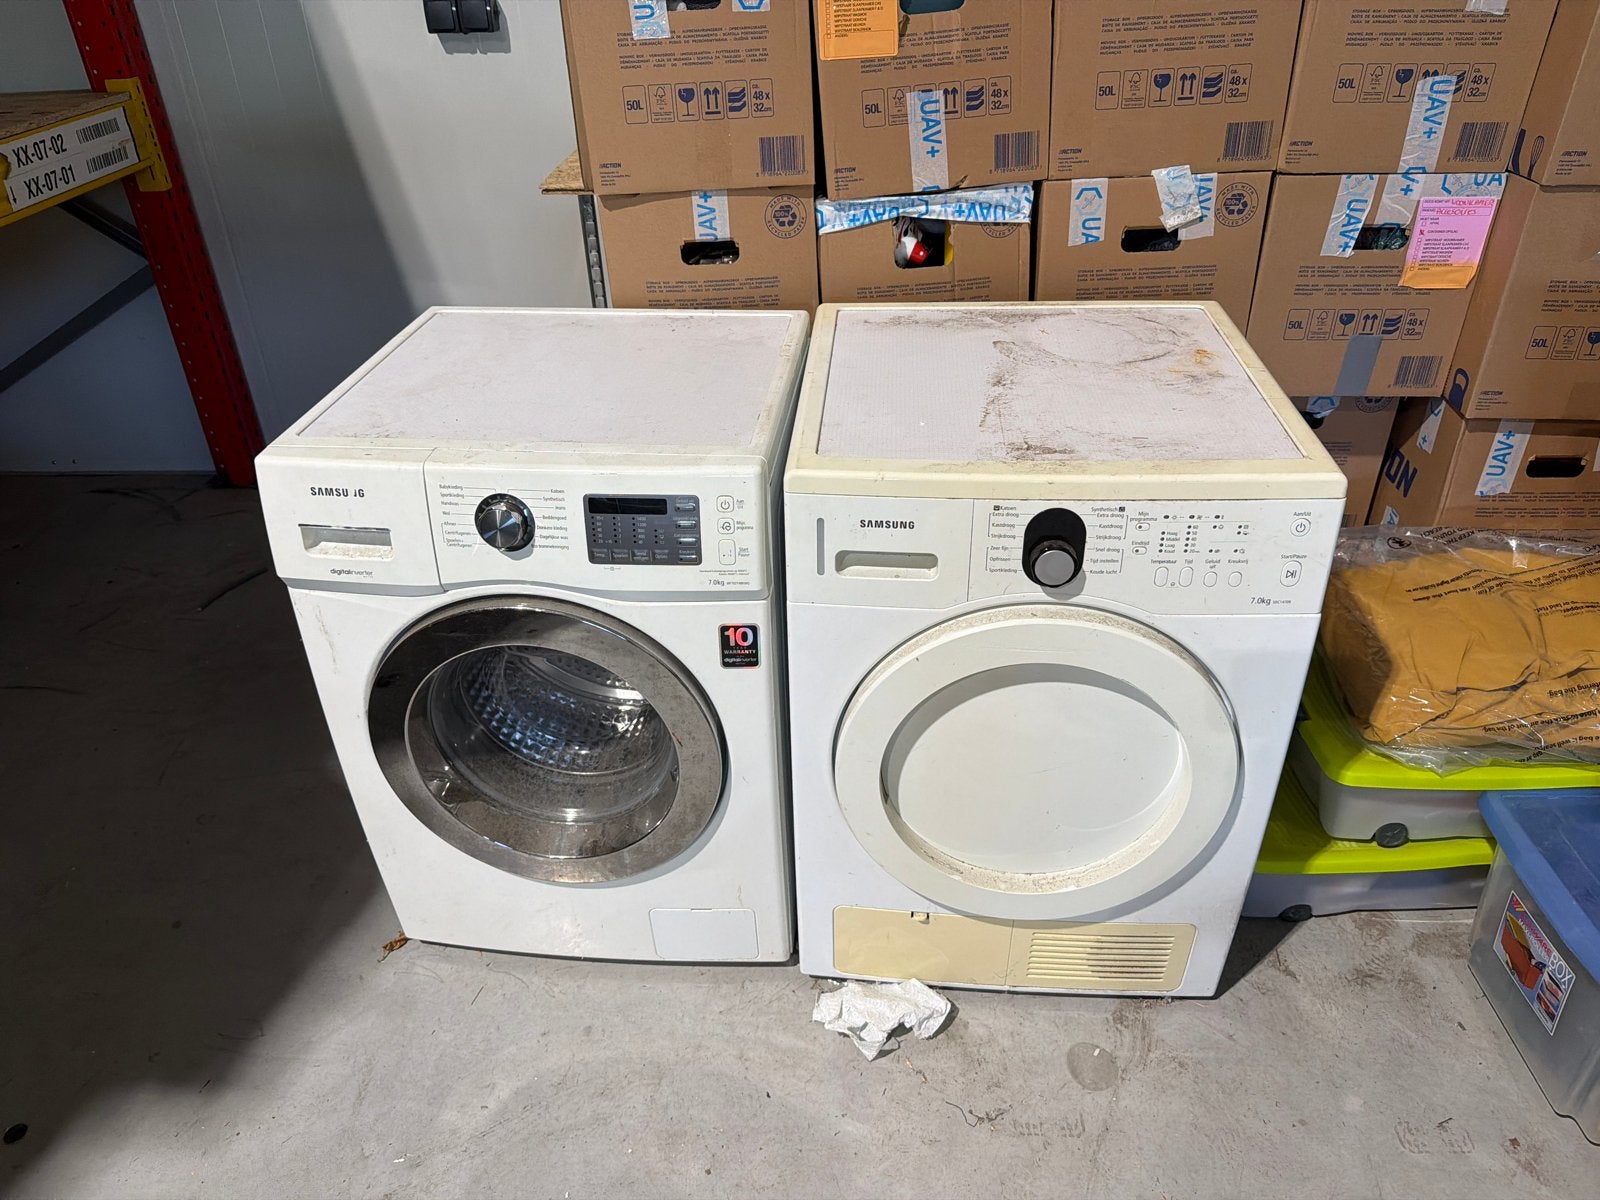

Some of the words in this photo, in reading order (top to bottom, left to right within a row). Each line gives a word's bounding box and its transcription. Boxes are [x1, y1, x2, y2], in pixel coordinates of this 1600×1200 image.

[1229, 76, 1240, 86] 48
[1338, 80, 1356, 89] 50L
[1471, 75, 1482, 84] 48
[753, 90, 764, 100] 48
[990, 89, 1002, 98] 48
[1098, 86, 1116, 96] 50L
[627, 100, 644, 110] 50L
[864, 104, 882, 114] 50L
[1423, 79, 1452, 138] UAV+
[920, 100, 942, 158] UAV+
[12, 134, 67, 168] XX-07-02
[24, 164, 76, 199] XX-07-01
[1338, 199, 1368, 252] UAV+
[1288, 321, 1304, 330] 50L
[1407, 318, 1418, 327] 48
[1532, 338, 1549, 348] 50L
[1486, 430, 1515, 476] UAV+
[860, 520, 915, 530] SAMSUNG
[1250, 597, 1271, 606] 7.0kg
[724, 628, 754, 646] 10
[1550, 954, 1572, 988] BOX
